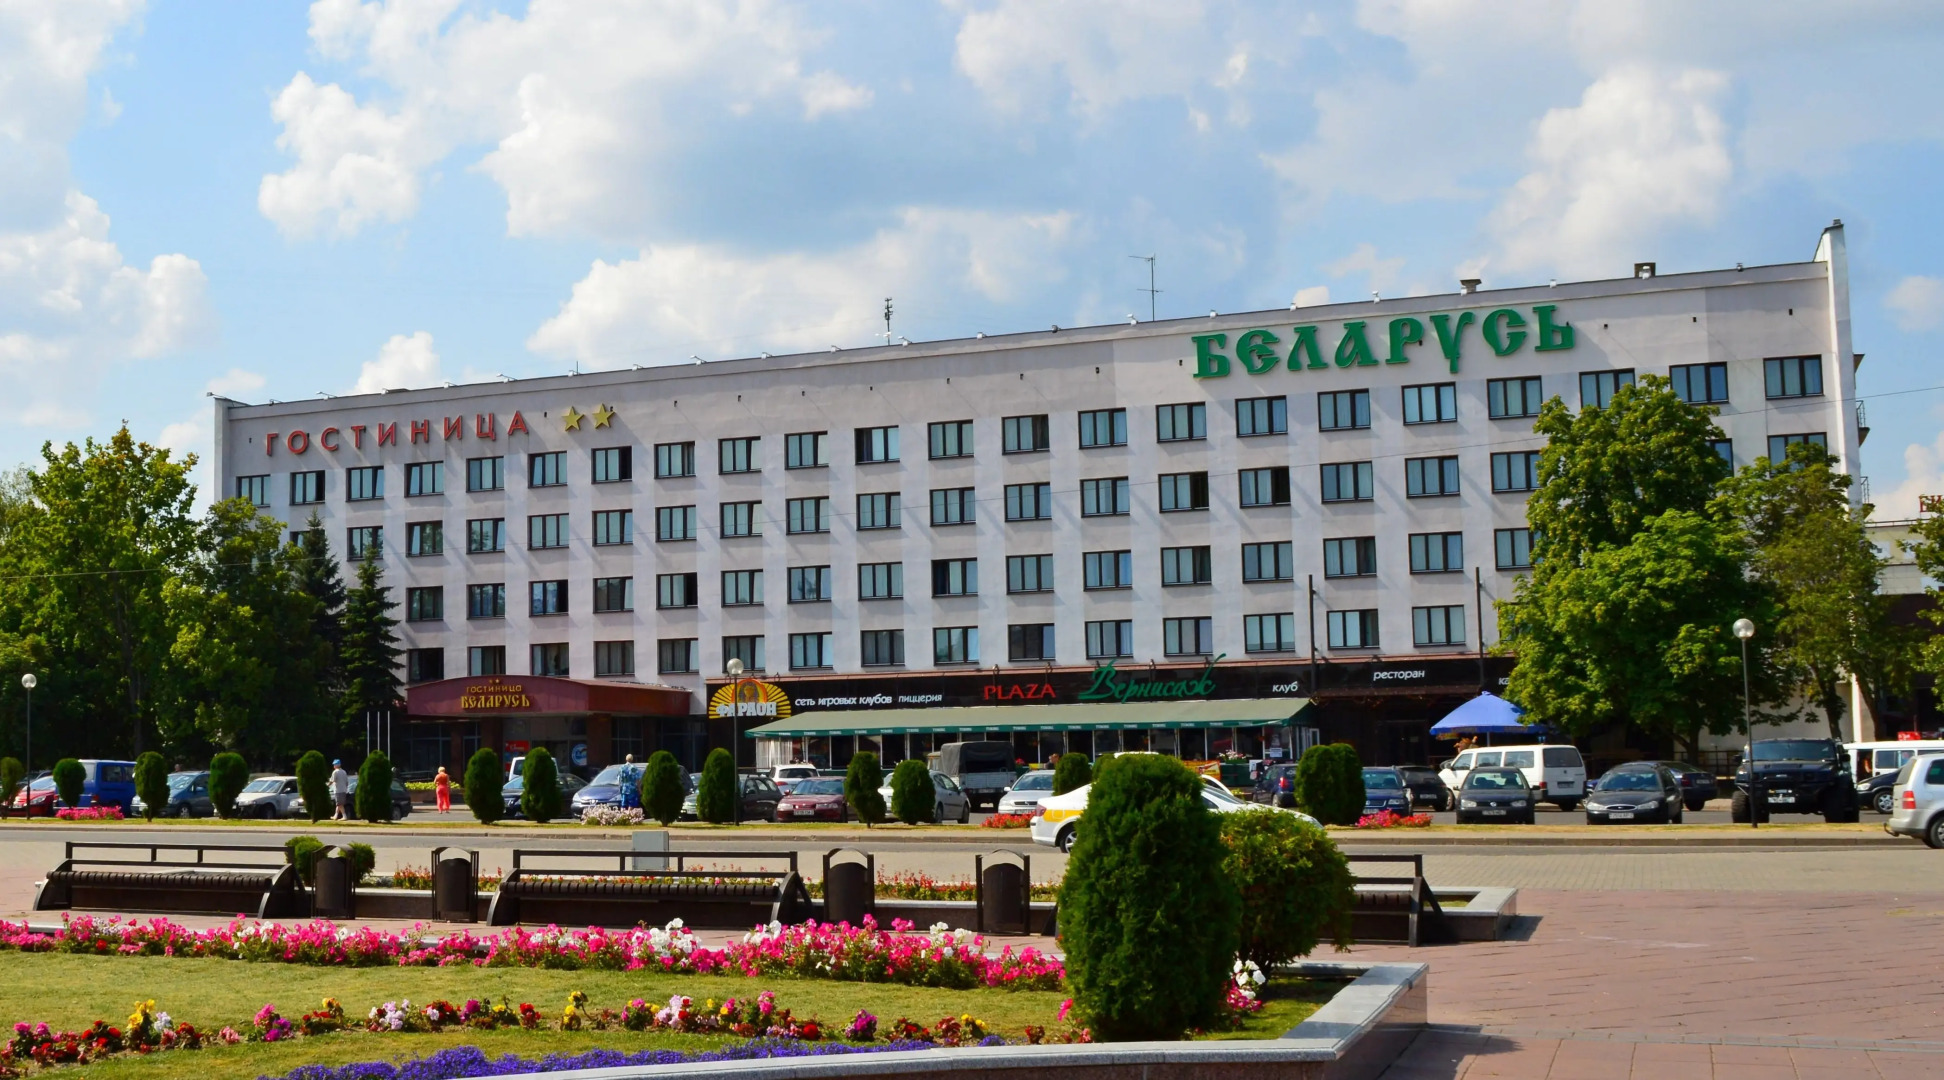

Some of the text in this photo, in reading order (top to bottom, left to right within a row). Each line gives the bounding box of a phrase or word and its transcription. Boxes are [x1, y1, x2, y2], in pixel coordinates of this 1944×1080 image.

[1191, 304, 1575, 379] БЕЛАРУСЬ
[265, 410, 528, 456] ГОСТИНИЦА
[1078, 653, 1226, 703] Вернисаж
[1373, 669, 1426, 681] ресторан
[984, 684, 1056, 700] PLAZA
[1272, 681, 1298, 693] клуб
[461, 694, 530, 709] БЕЛАРУСЬ
[795, 693, 893, 707] сеть игровых клубов
[898, 694, 943, 704] пиццерия
[715, 701, 777, 717] ФАРАОН
